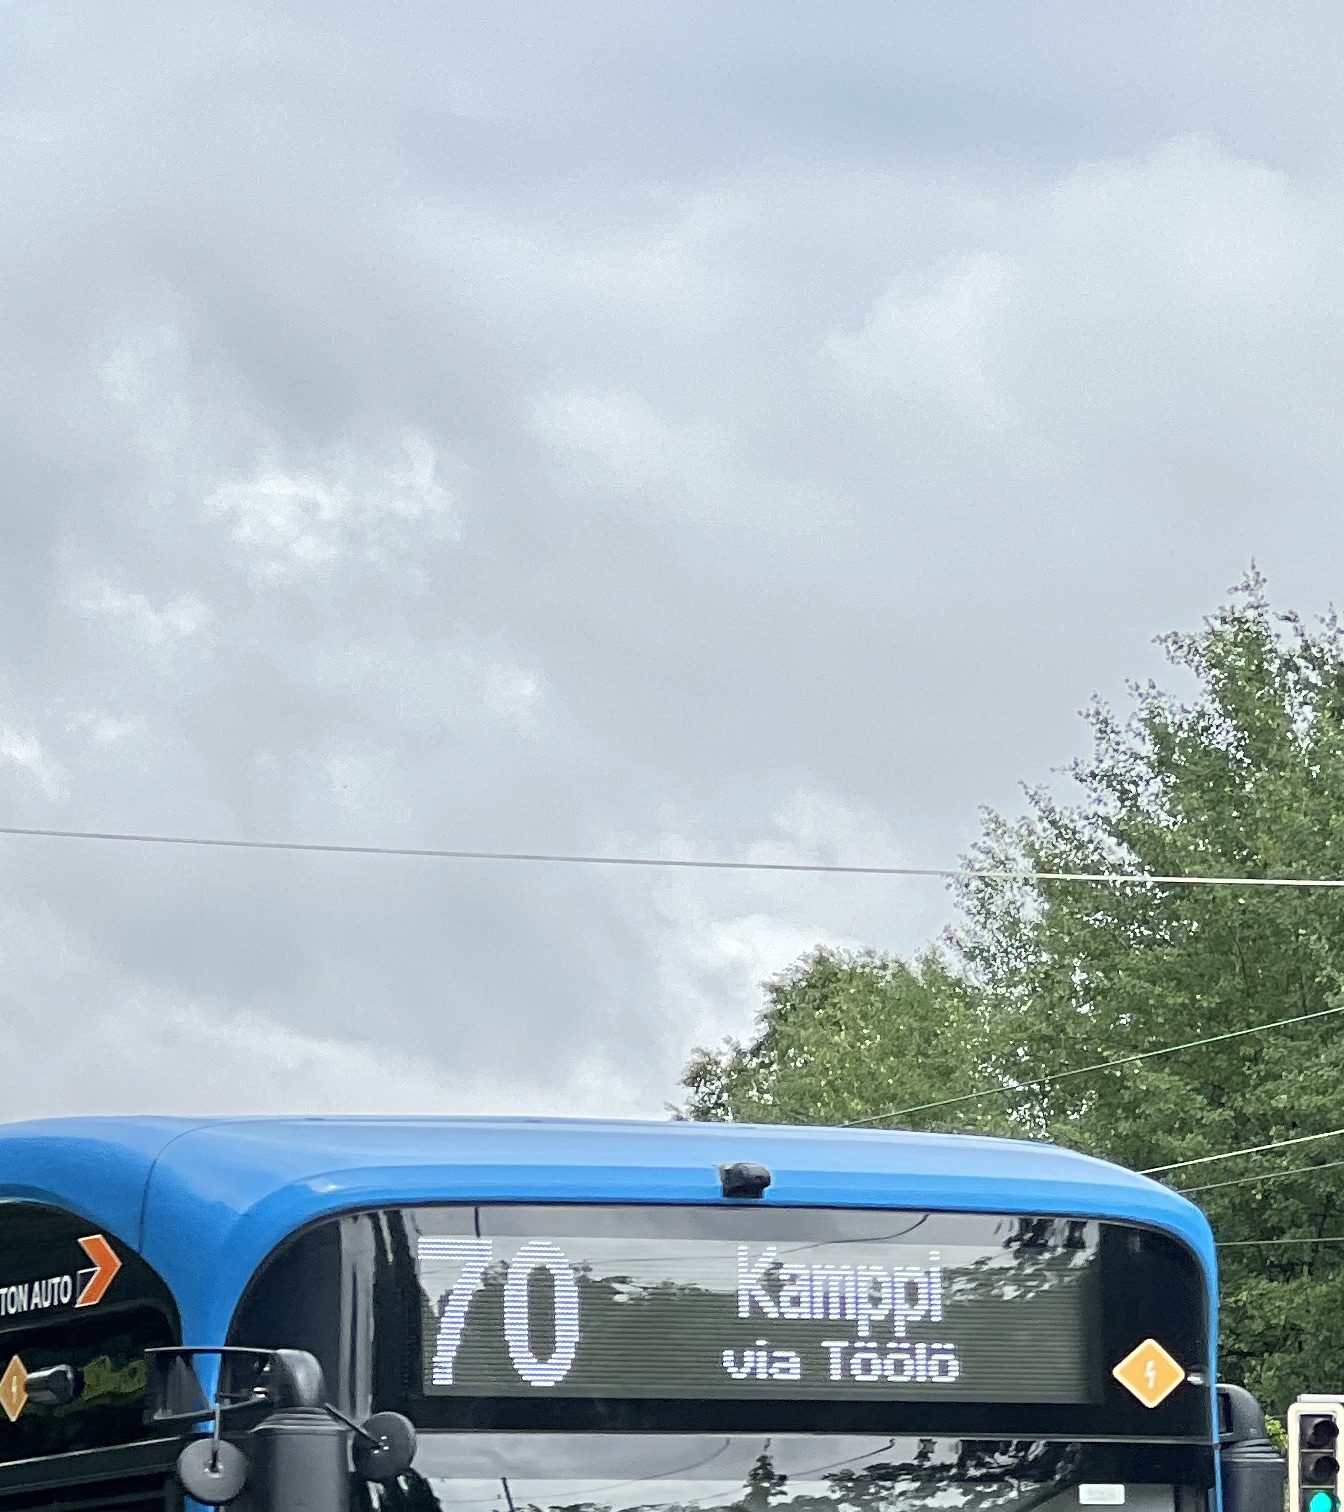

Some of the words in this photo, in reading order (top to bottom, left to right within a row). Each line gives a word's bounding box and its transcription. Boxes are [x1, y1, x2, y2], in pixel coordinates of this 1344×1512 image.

[30, 1274, 73, 1312] AUTO
[417, 1238, 581, 1387] 70
[737, 1245, 943, 1337] Kamppi
[722, 1339, 802, 1380] via
[820, 1341, 960, 1383] Töölö
